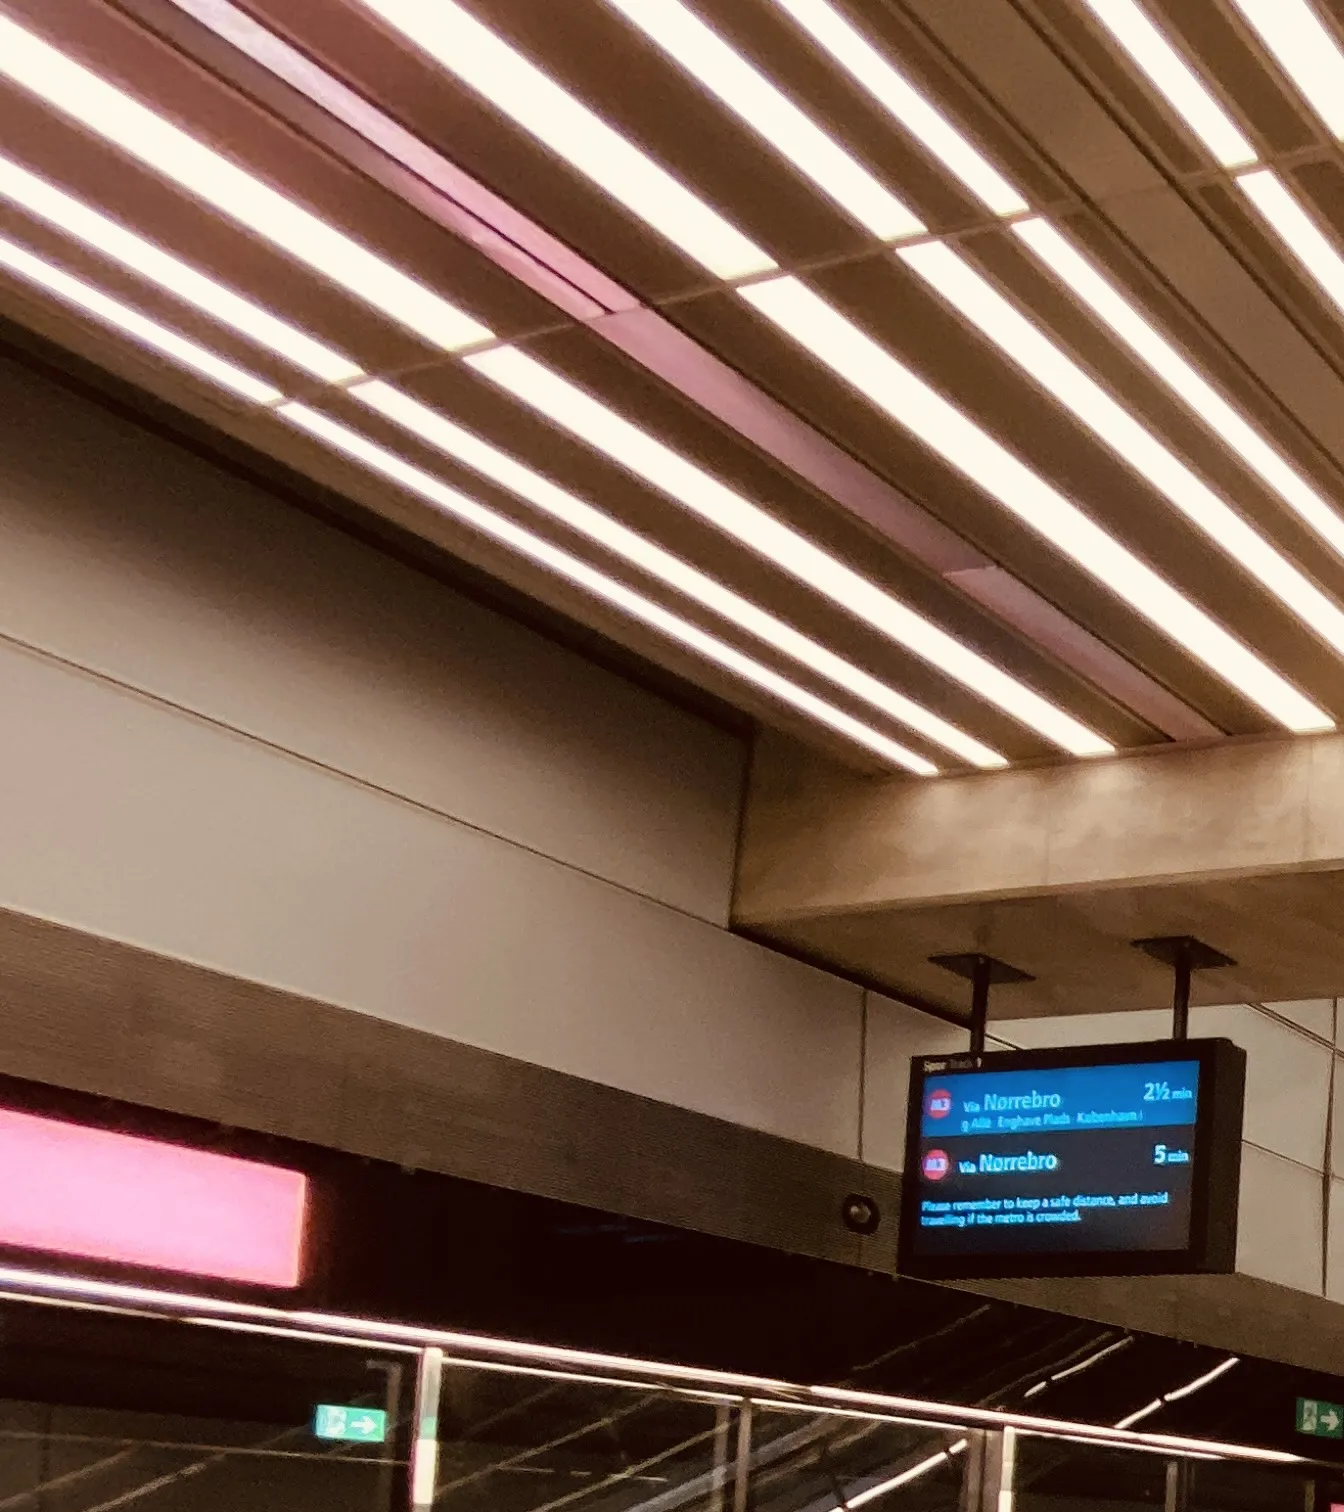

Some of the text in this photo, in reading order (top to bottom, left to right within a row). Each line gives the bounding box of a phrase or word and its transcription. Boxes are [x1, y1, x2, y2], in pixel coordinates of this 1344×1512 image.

[963, 1101, 980, 1112] Via
[1143, 1081, 1170, 1100] 2½
[1172, 1087, 1192, 1099] min
[959, 1161, 976, 1173] Via
[1154, 1144, 1166, 1165] 5
[1168, 1150, 1189, 1162] min
[953, 1198, 1000, 1210] remember
[1004, 1199, 1014, 1209] to
[1016, 1197, 1040, 1210] keep
[1042, 1198, 1048, 1208] a
[1050, 1195, 1071, 1207] safe
[1118, 1192, 1138, 1205] and
[1140, 1191, 1168, 1204] avoid
[967, 1212, 974, 1224] if
[977, 1213, 993, 1224] the
[995, 1213, 1024, 1223] metro
